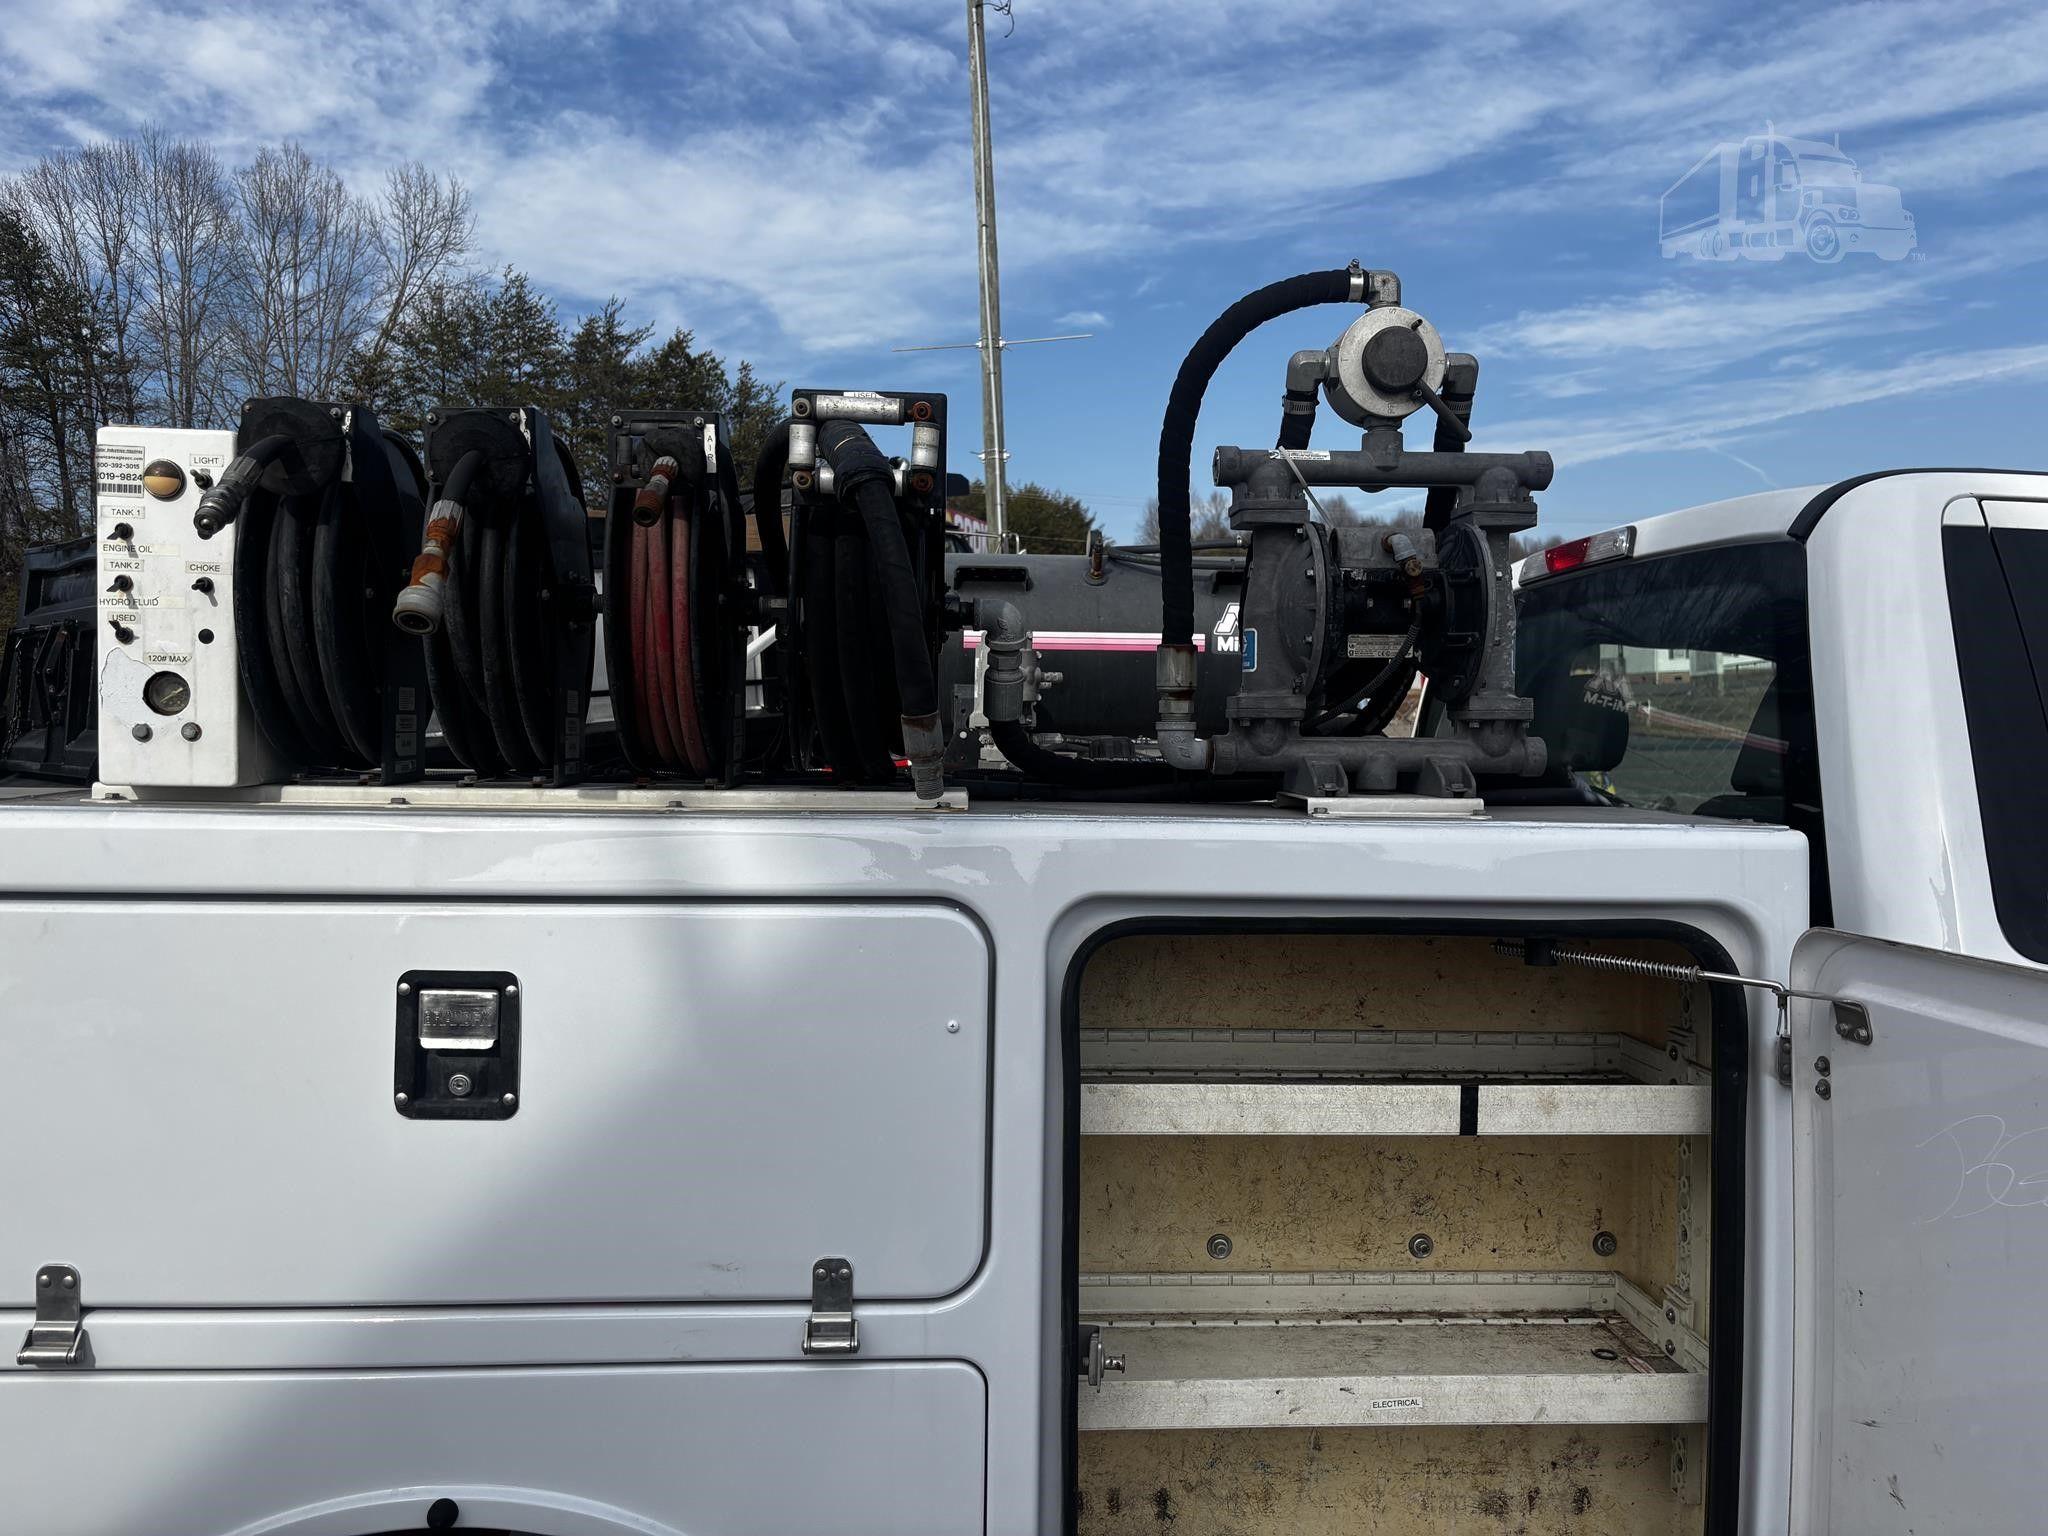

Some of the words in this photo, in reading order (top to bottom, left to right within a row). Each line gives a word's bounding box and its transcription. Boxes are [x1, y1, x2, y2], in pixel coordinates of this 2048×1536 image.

[193, 457, 220, 465] LIGHT
[111, 508, 134, 516] TANK
[136, 509, 141, 517] 1
[103, 544, 136, 553] ENGINE
[138, 545, 153, 554] OIL
[109, 561, 132, 569] TANK
[189, 563, 221, 572] CHOKE
[99, 598, 130, 606] HYDRO
[133, 598, 159, 606] FLUID
[112, 614, 137, 622] USED
[1217, 636, 1241, 652] Mi
[168, 655, 188, 663] MAX
[1372, 1399, 1420, 1409] ELECTRICAL
